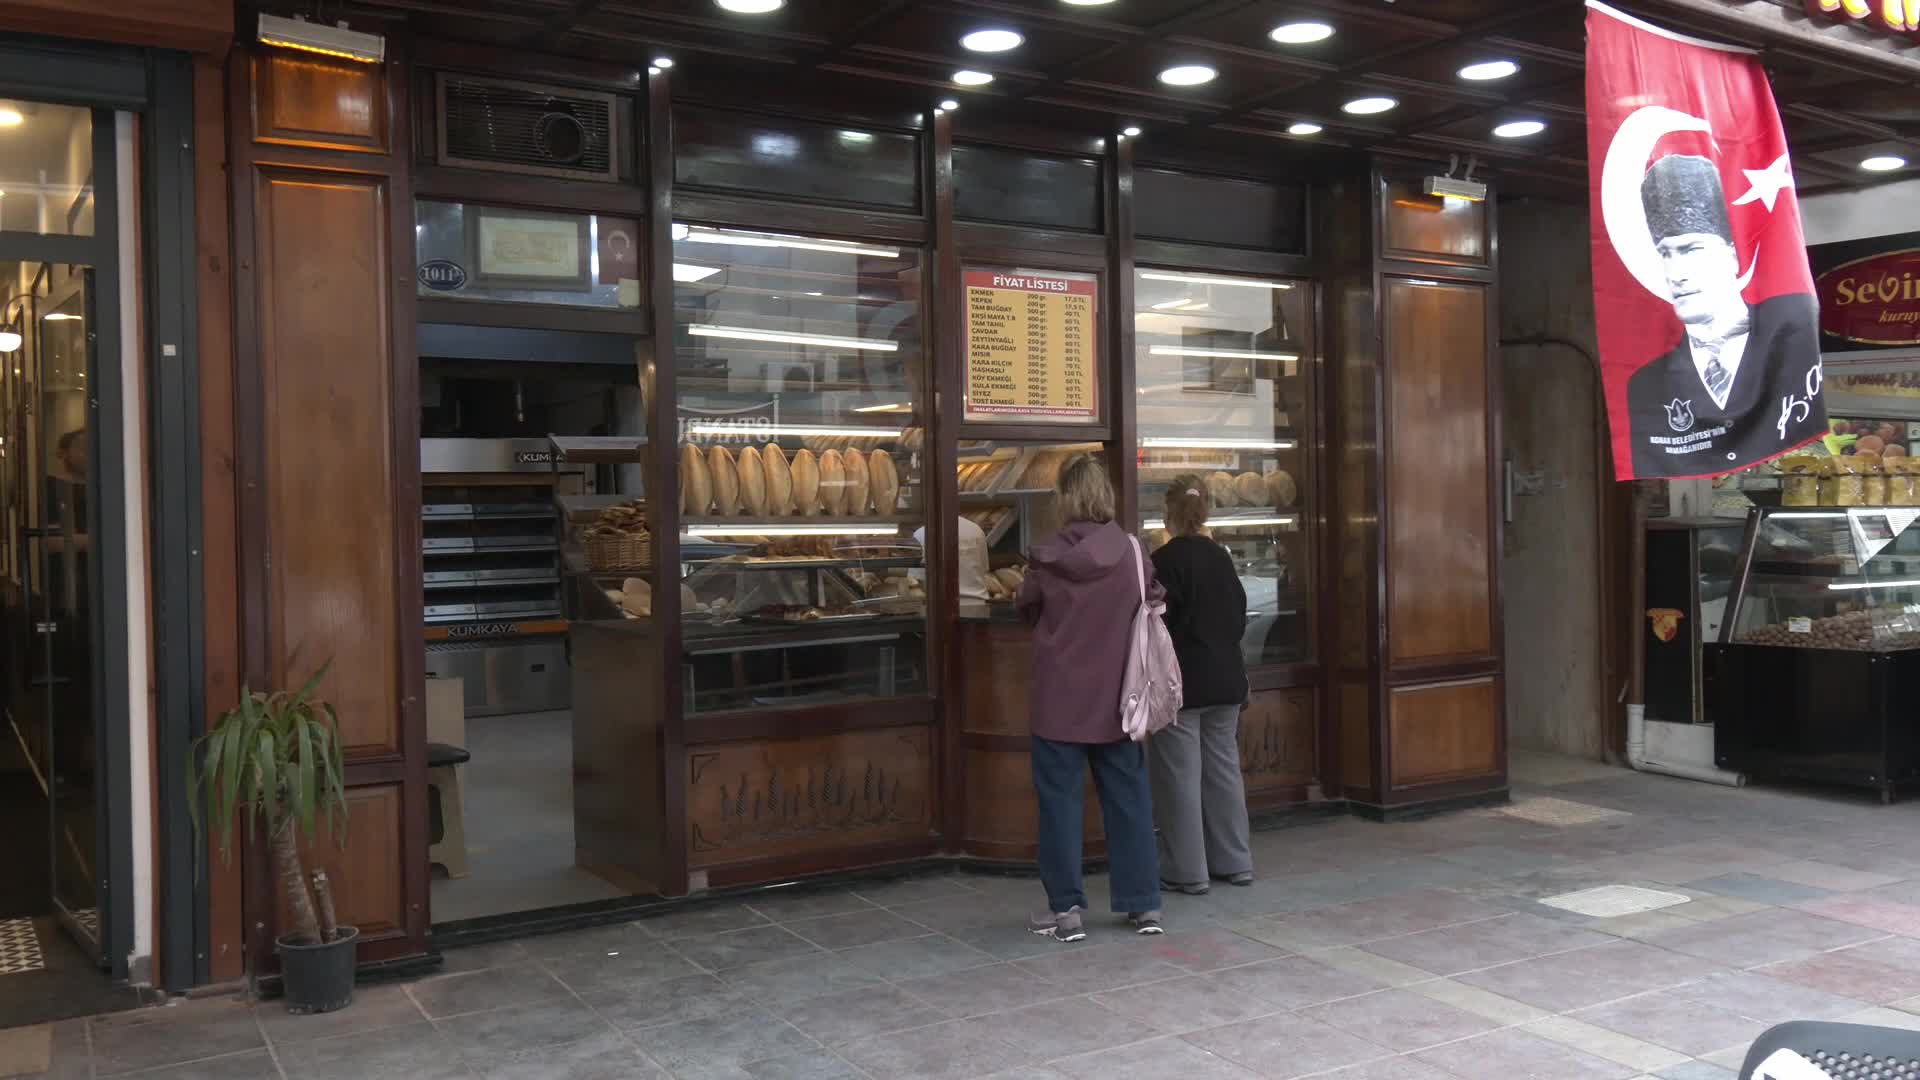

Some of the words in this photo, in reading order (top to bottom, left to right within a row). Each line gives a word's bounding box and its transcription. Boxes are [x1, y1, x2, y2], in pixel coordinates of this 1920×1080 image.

[993, 274, 1024, 288] FİYAT
[1027, 278, 1068, 291] LİSTESİ
[447, 623, 518, 637] KUMKAYA
